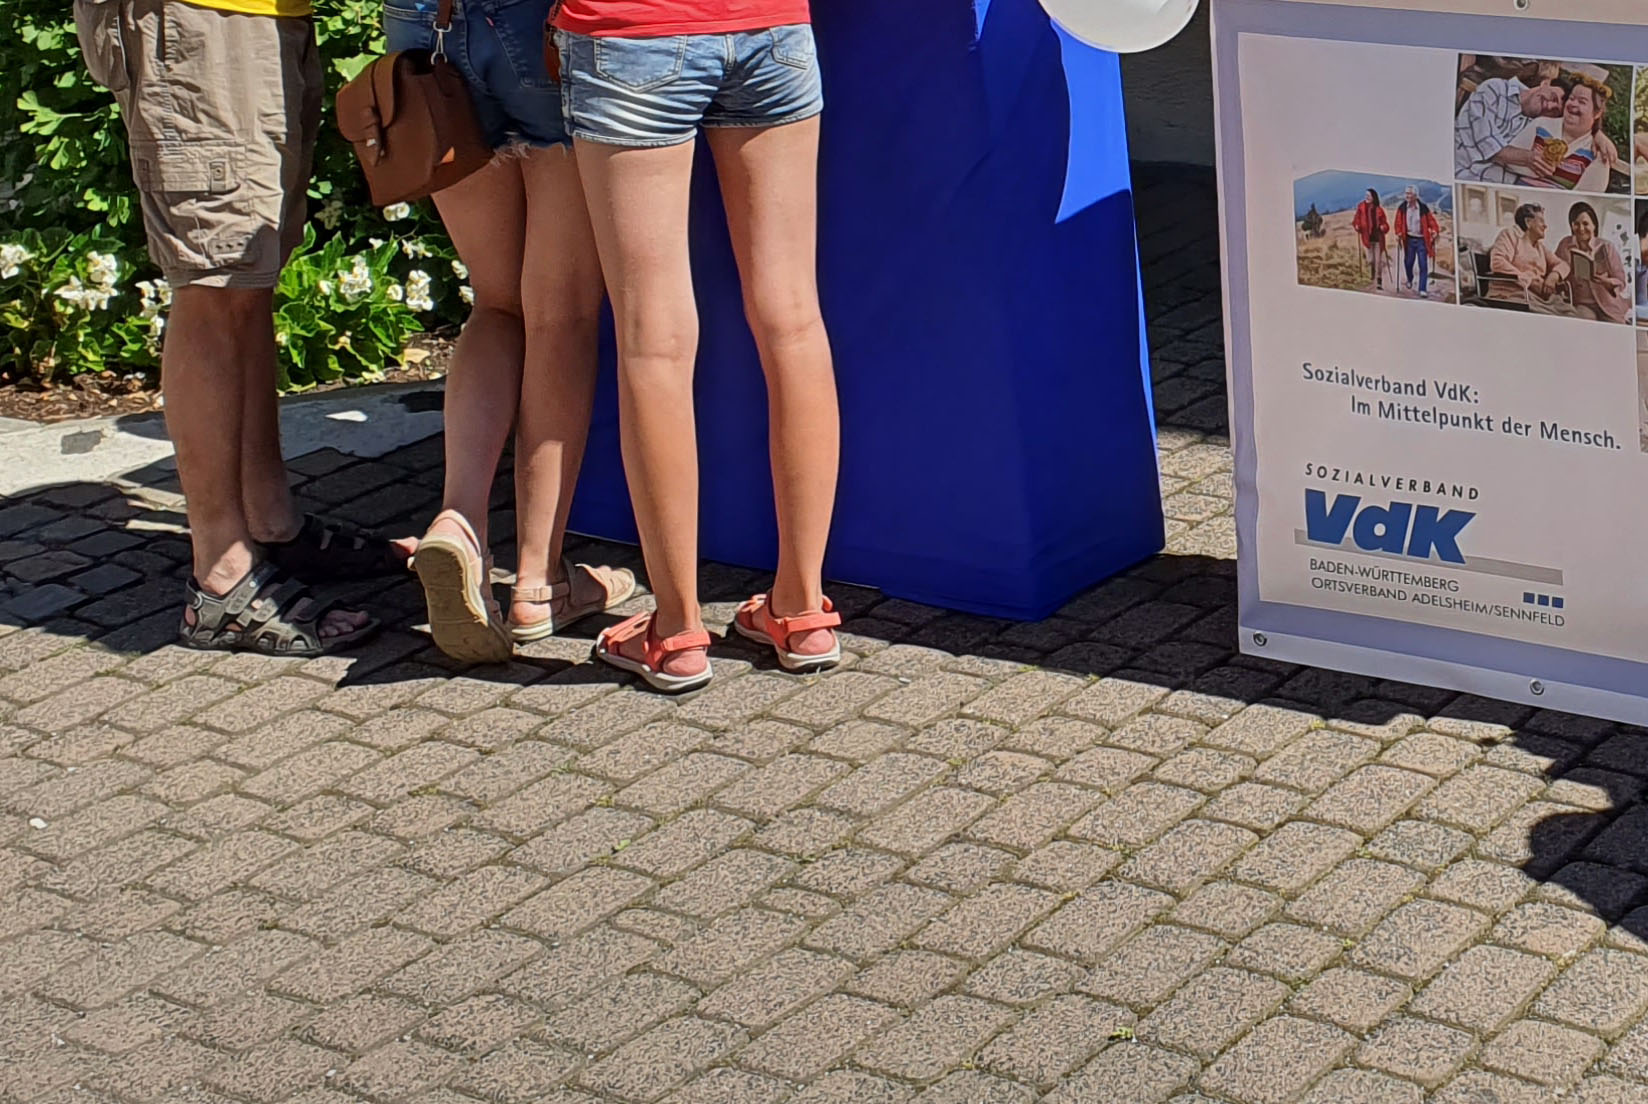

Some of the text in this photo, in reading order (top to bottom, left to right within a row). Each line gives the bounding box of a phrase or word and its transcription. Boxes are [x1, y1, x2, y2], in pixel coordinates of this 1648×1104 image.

[1302, 362, 1480, 404] Sozialverband VdK:
[1351, 395, 1622, 450] Im Mittelpunkt der Mensch.
[1305, 462, 1480, 500] SOZIALVERBAND
[1305, 488, 1476, 565] VdK
[1309, 557, 1460, 592] BADEN-WÜRTTEMBERG
[1311, 577, 1566, 627] ORTSVERBAND ADELSHEIM/SENNFELD
